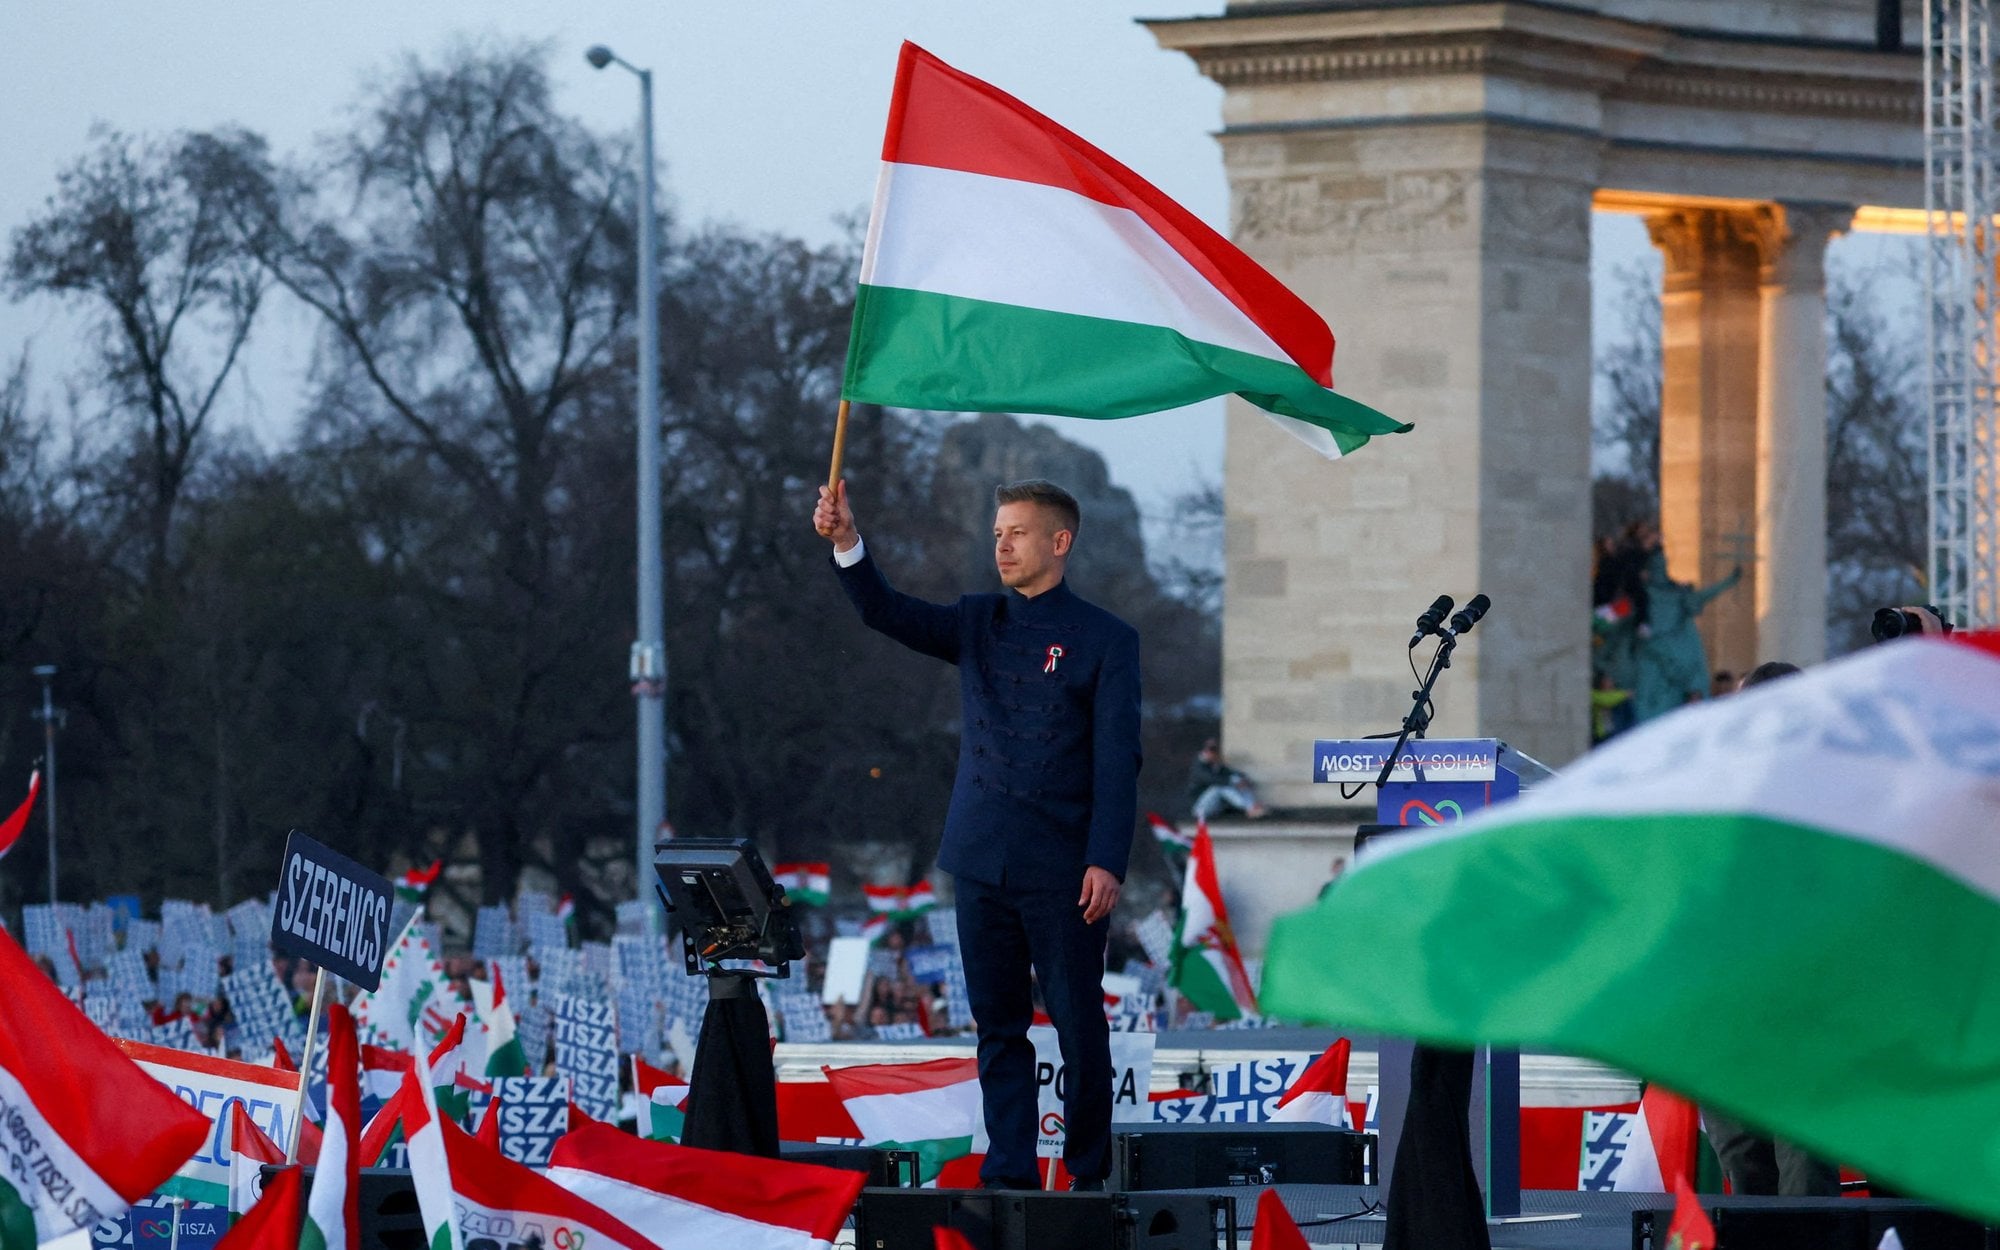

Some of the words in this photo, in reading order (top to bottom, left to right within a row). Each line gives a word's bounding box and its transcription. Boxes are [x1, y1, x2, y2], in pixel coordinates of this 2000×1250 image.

[1321, 755, 1373, 771] MOST
[1431, 754, 1488, 771] SOHA!
[281, 853, 386, 973] SZERENCS
[556, 994, 616, 1029] TISZA
[556, 1017, 617, 1053] TISZA
[556, 1041, 619, 1078] TISZA
[469, 1106, 569, 1133] TSZA
[178, 1223, 216, 1235] TISZA
